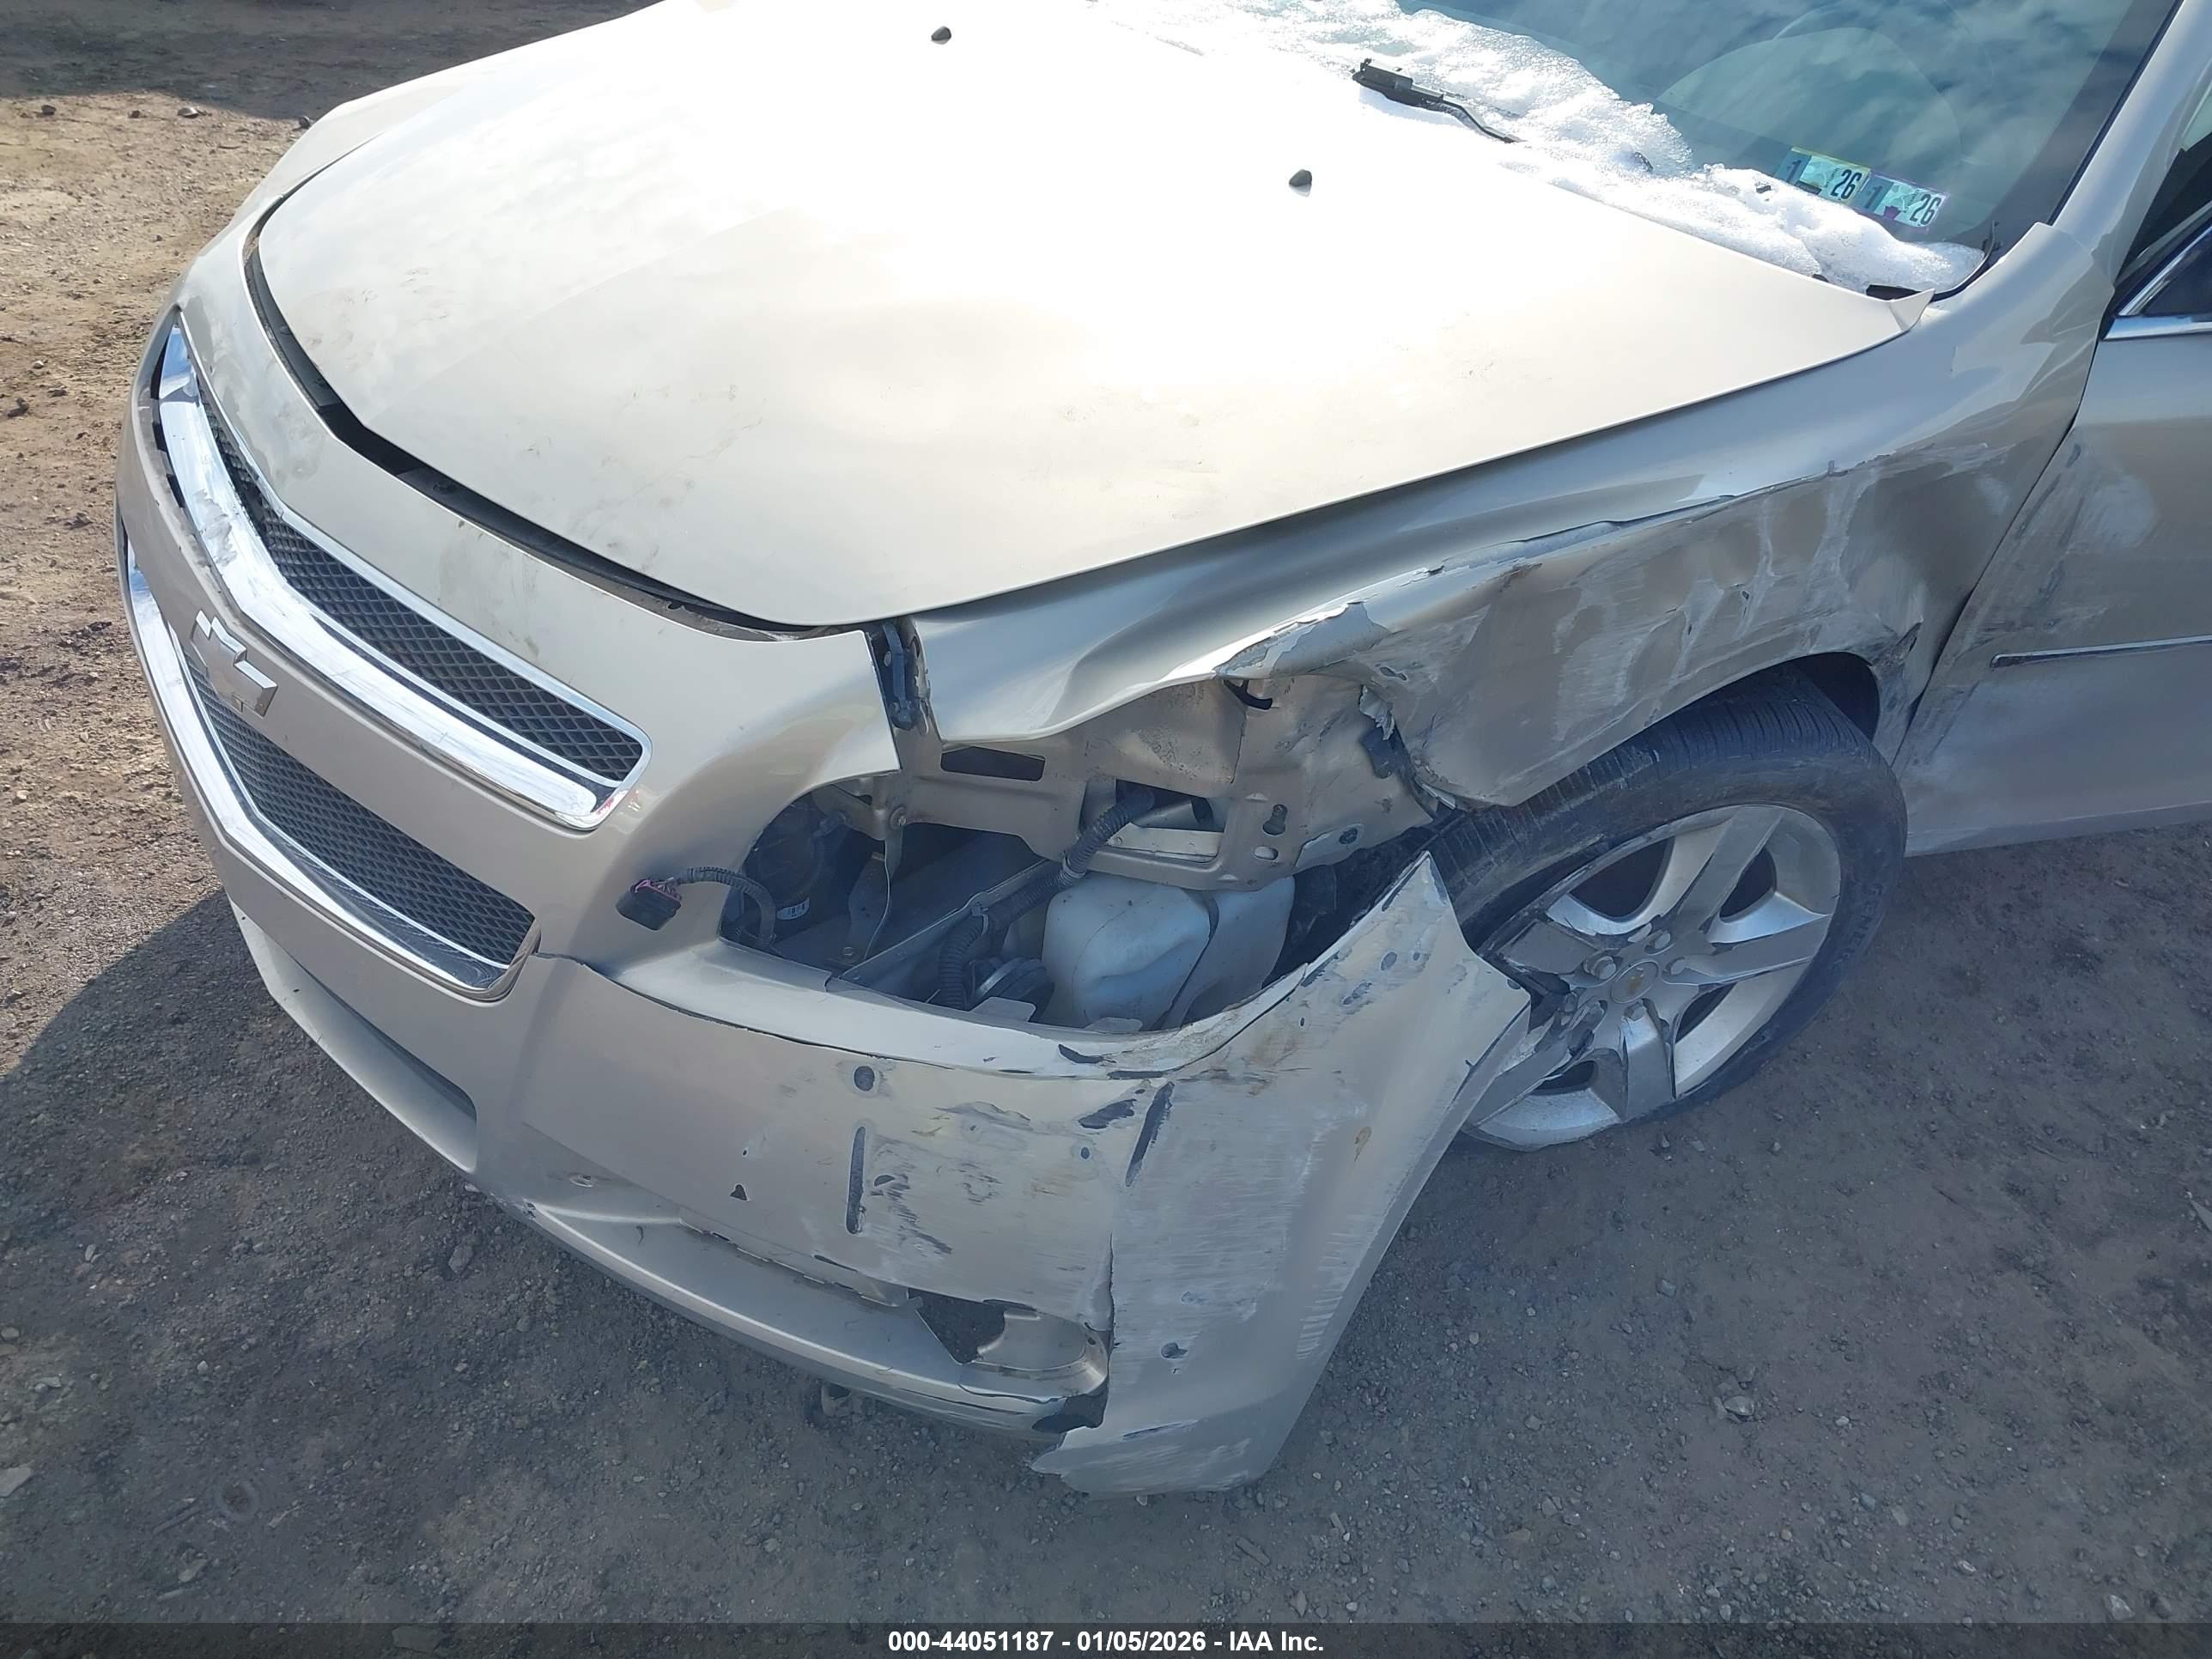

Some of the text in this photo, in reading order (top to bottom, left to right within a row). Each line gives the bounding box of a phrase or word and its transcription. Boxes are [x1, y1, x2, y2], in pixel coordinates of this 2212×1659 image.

[1785, 159, 1802, 183] 1
[1829, 168, 1863, 200] 26
[1865, 185, 1884, 209] 1
[1910, 193, 1942, 225] 26
